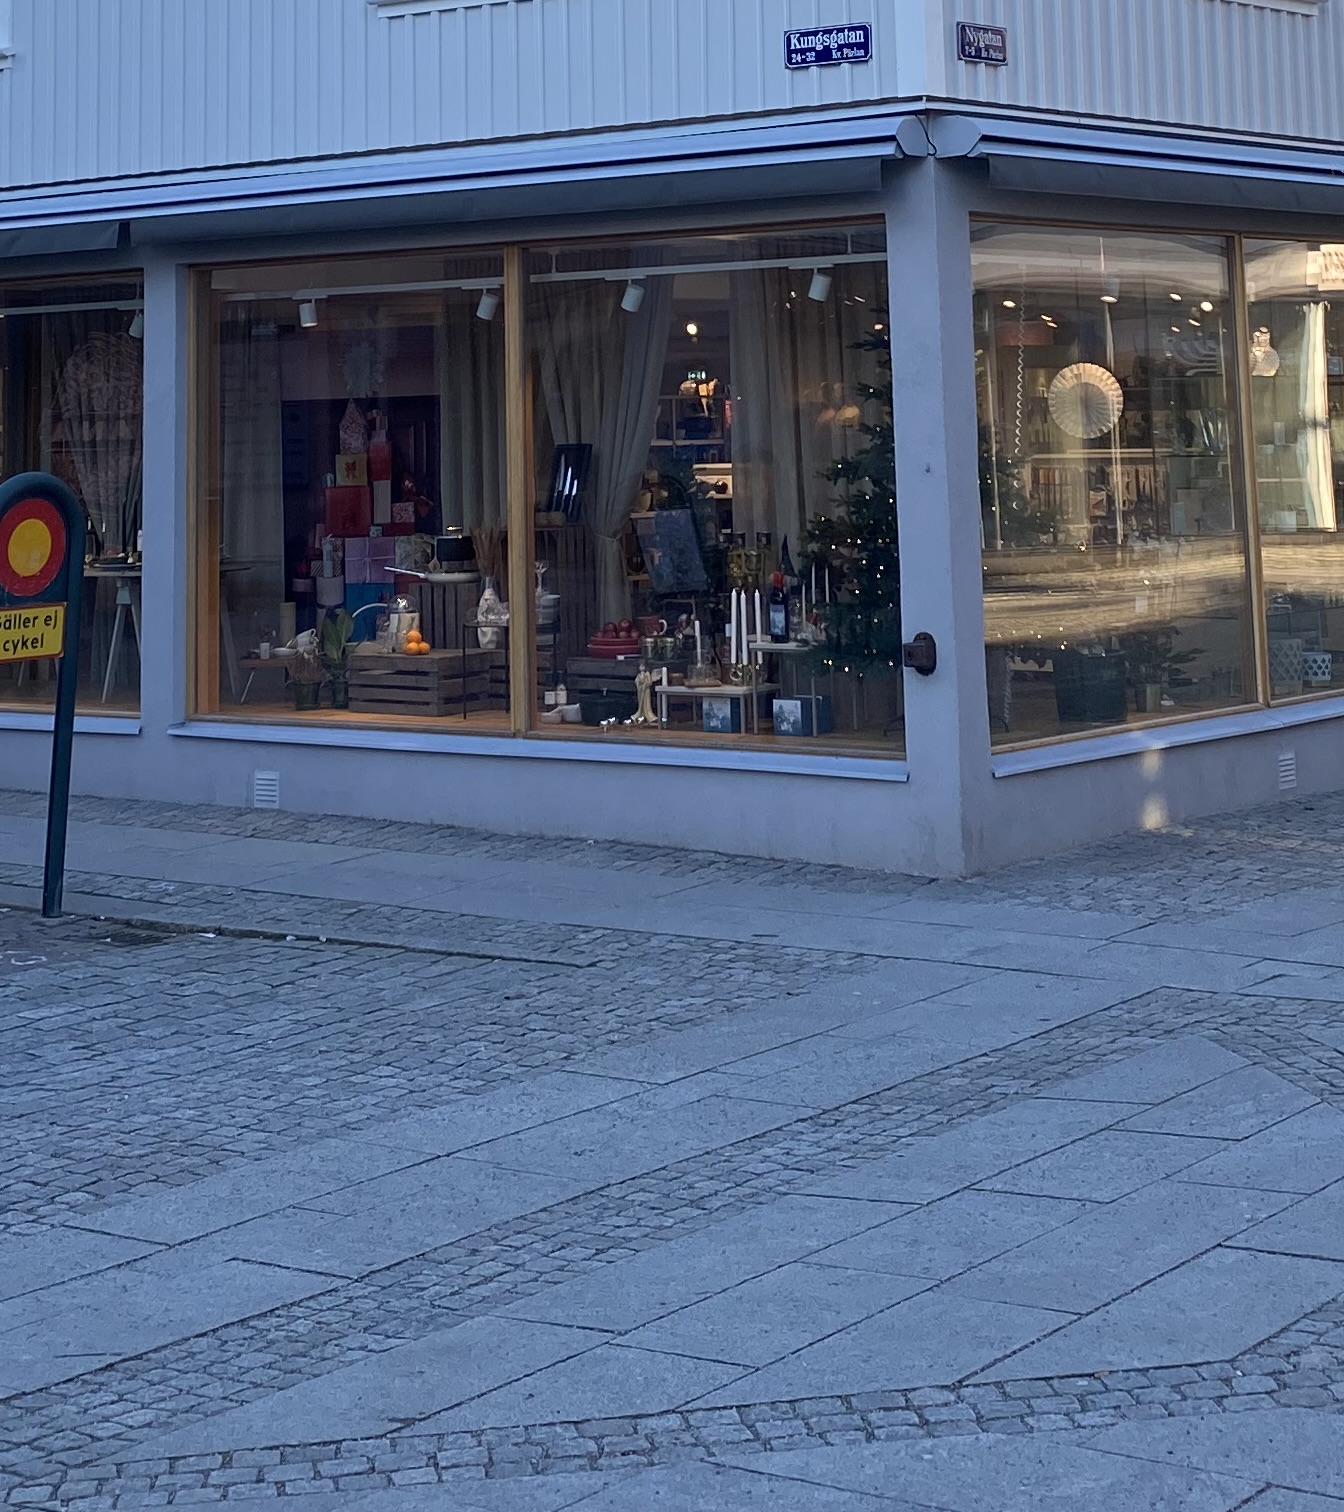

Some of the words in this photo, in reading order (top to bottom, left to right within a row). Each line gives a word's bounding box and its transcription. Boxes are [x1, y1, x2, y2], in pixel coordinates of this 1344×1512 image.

[790, 29, 864, 50] Kungsgatan
[965, 26, 1002, 48] Nygatan
[791, 52, 815, 63] 24-32
[44, 610, 58, 629] ej
[2, 633, 45, 655] cykel
